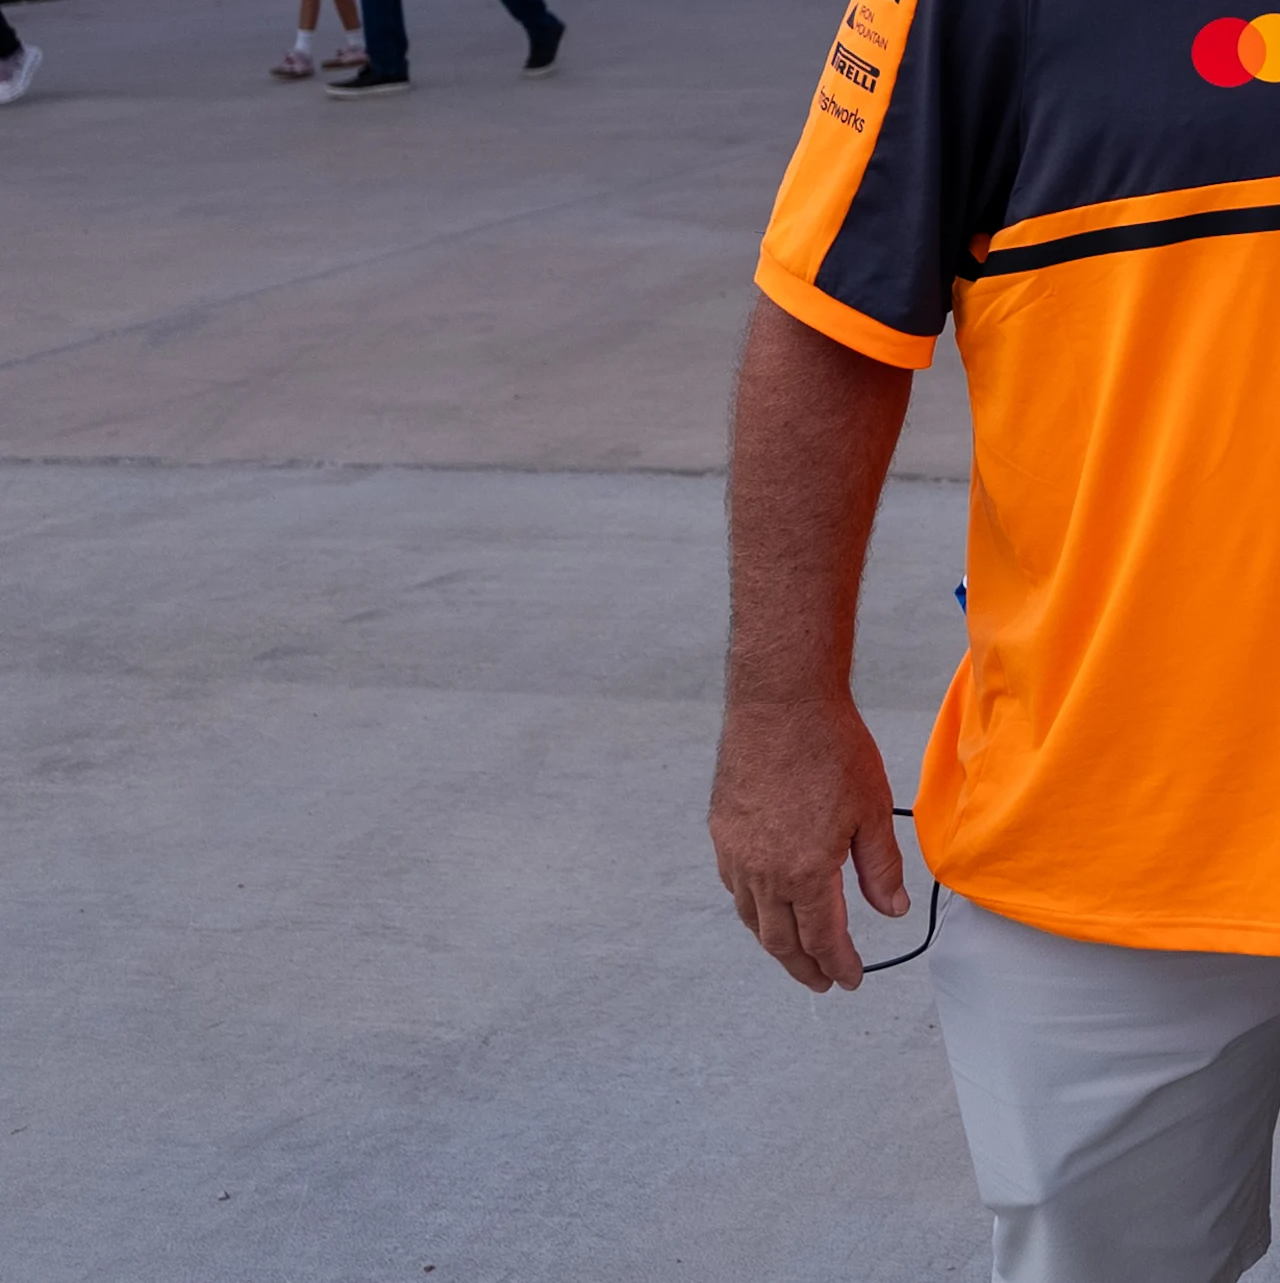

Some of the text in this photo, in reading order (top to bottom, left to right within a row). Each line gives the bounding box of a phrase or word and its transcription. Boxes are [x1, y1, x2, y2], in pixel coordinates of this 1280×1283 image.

[859, 5, 875, 23] IRON
[854, 20, 889, 51] MOUNTAIN
[831, 41, 881, 94] PIRELLI
